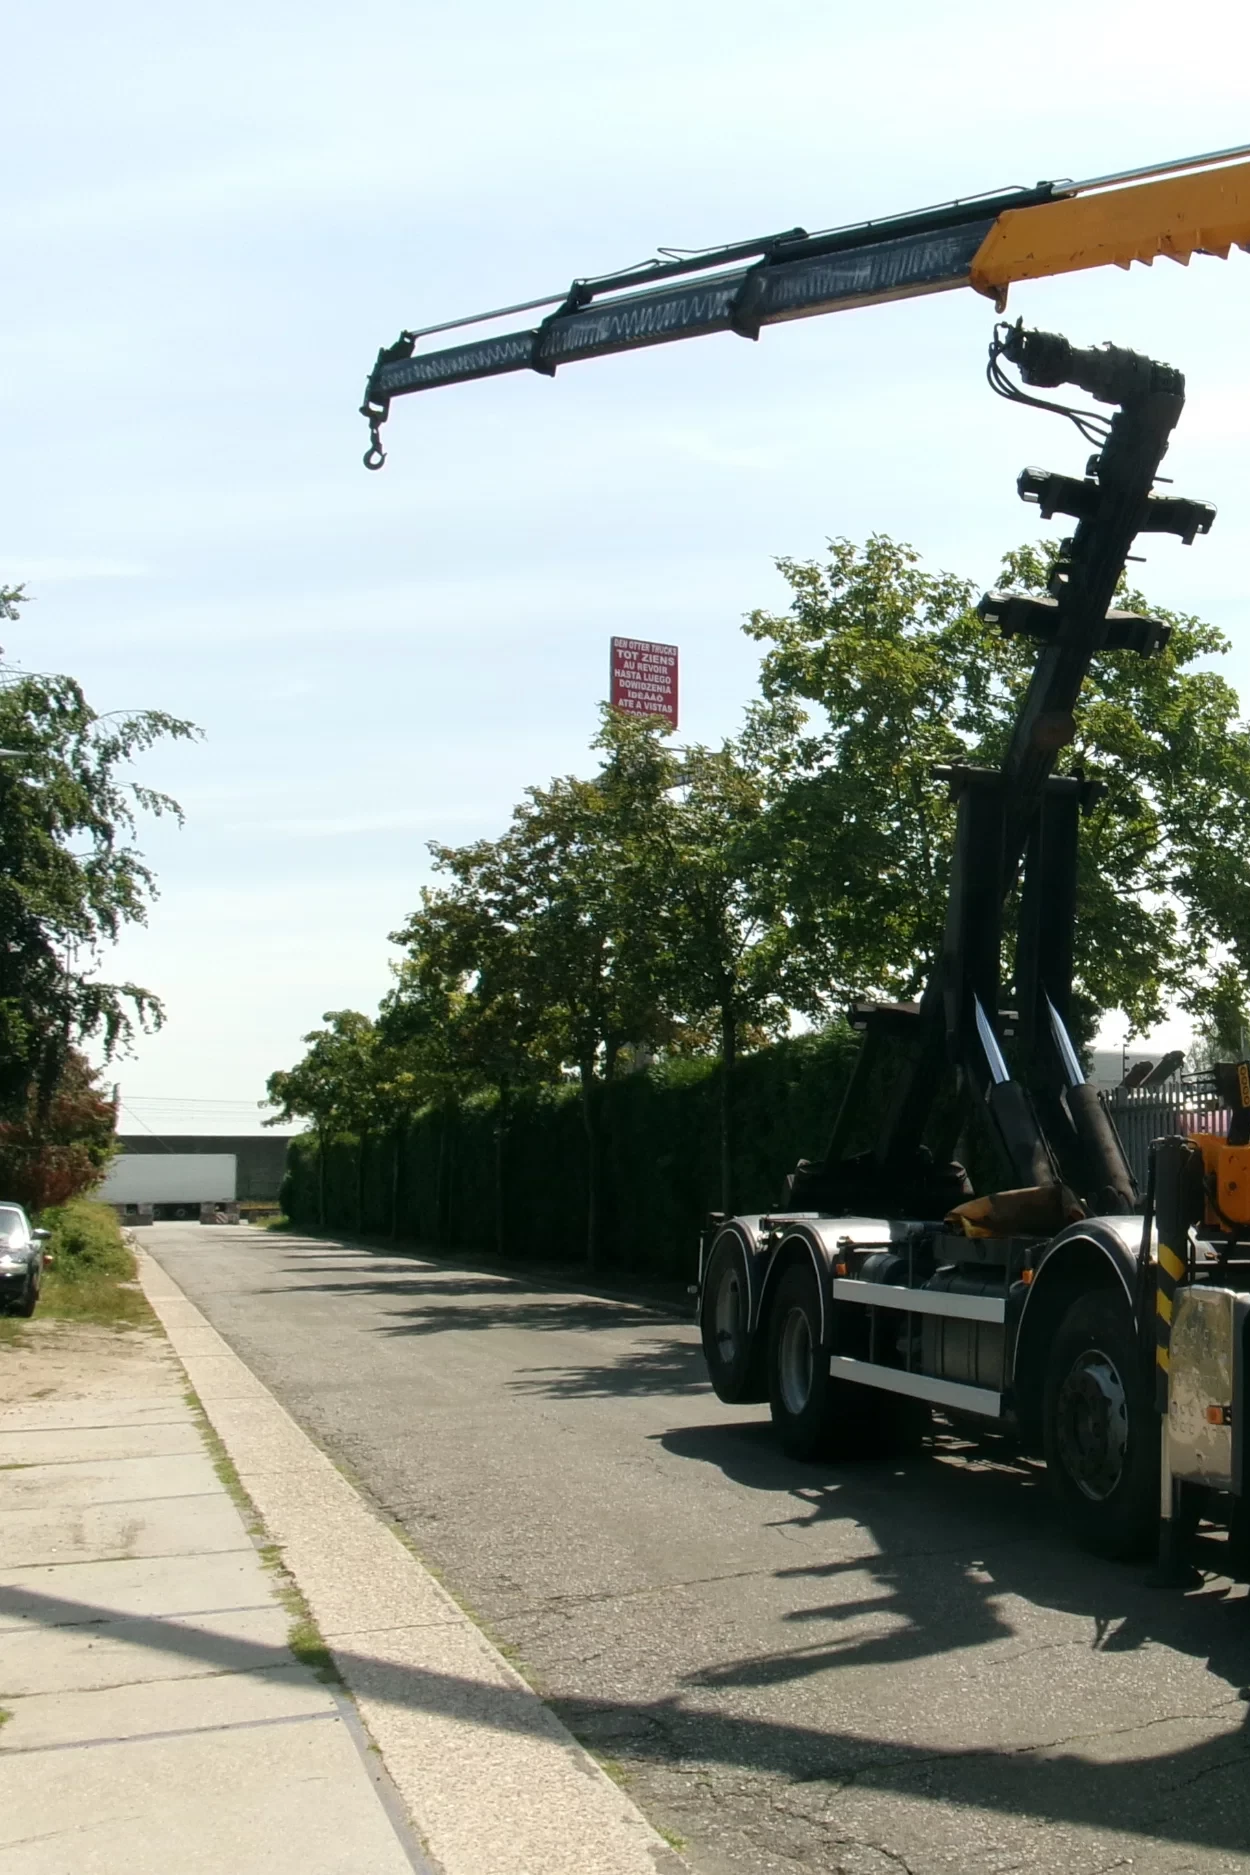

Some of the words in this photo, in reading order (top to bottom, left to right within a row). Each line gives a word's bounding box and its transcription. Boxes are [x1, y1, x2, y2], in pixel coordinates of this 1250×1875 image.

[614, 638, 628, 647] DEN
[628, 640, 650, 652] OTTER
[651, 644, 677, 656] TRUCKS
[616, 649, 639, 660] TOT
[641, 653, 675, 666] ZIENS
[623, 660, 635, 669] AU
[637, 662, 668, 675] REVOIR
[614, 669, 642, 680] HASTA
[643, 673, 672, 684] LUEGO
[618, 698, 634, 708] ATE
[635, 700, 642, 710] A
[643, 701, 673, 713] VISTAS
